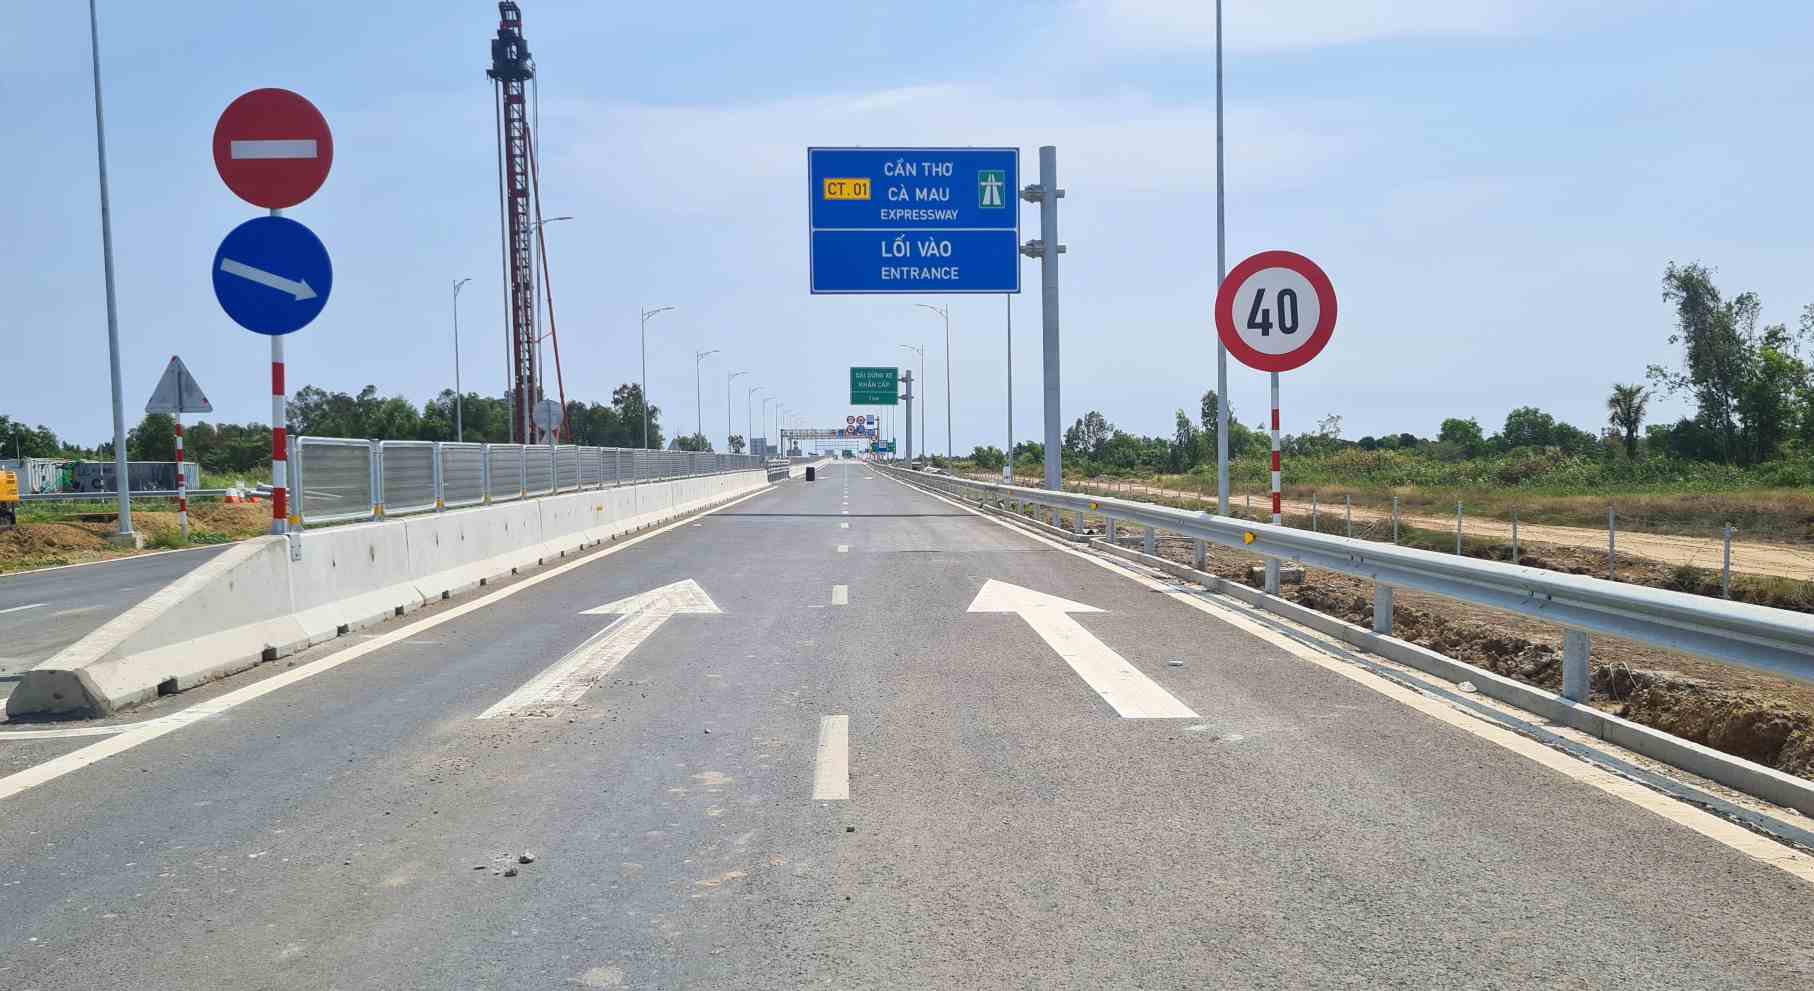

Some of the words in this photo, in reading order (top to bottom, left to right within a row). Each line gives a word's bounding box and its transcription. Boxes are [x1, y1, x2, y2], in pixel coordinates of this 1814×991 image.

[921, 161, 954, 177] THƠ
[888, 183, 909, 201] CÀ
[915, 187, 950, 201] MAU
[880, 209, 959, 221] EXPRESSWAY
[881, 233, 911, 257] LỐI
[917, 236, 952, 257] VÀO
[881, 266, 960, 280] ENTRANCE
[1246, 287, 1299, 337] 40
